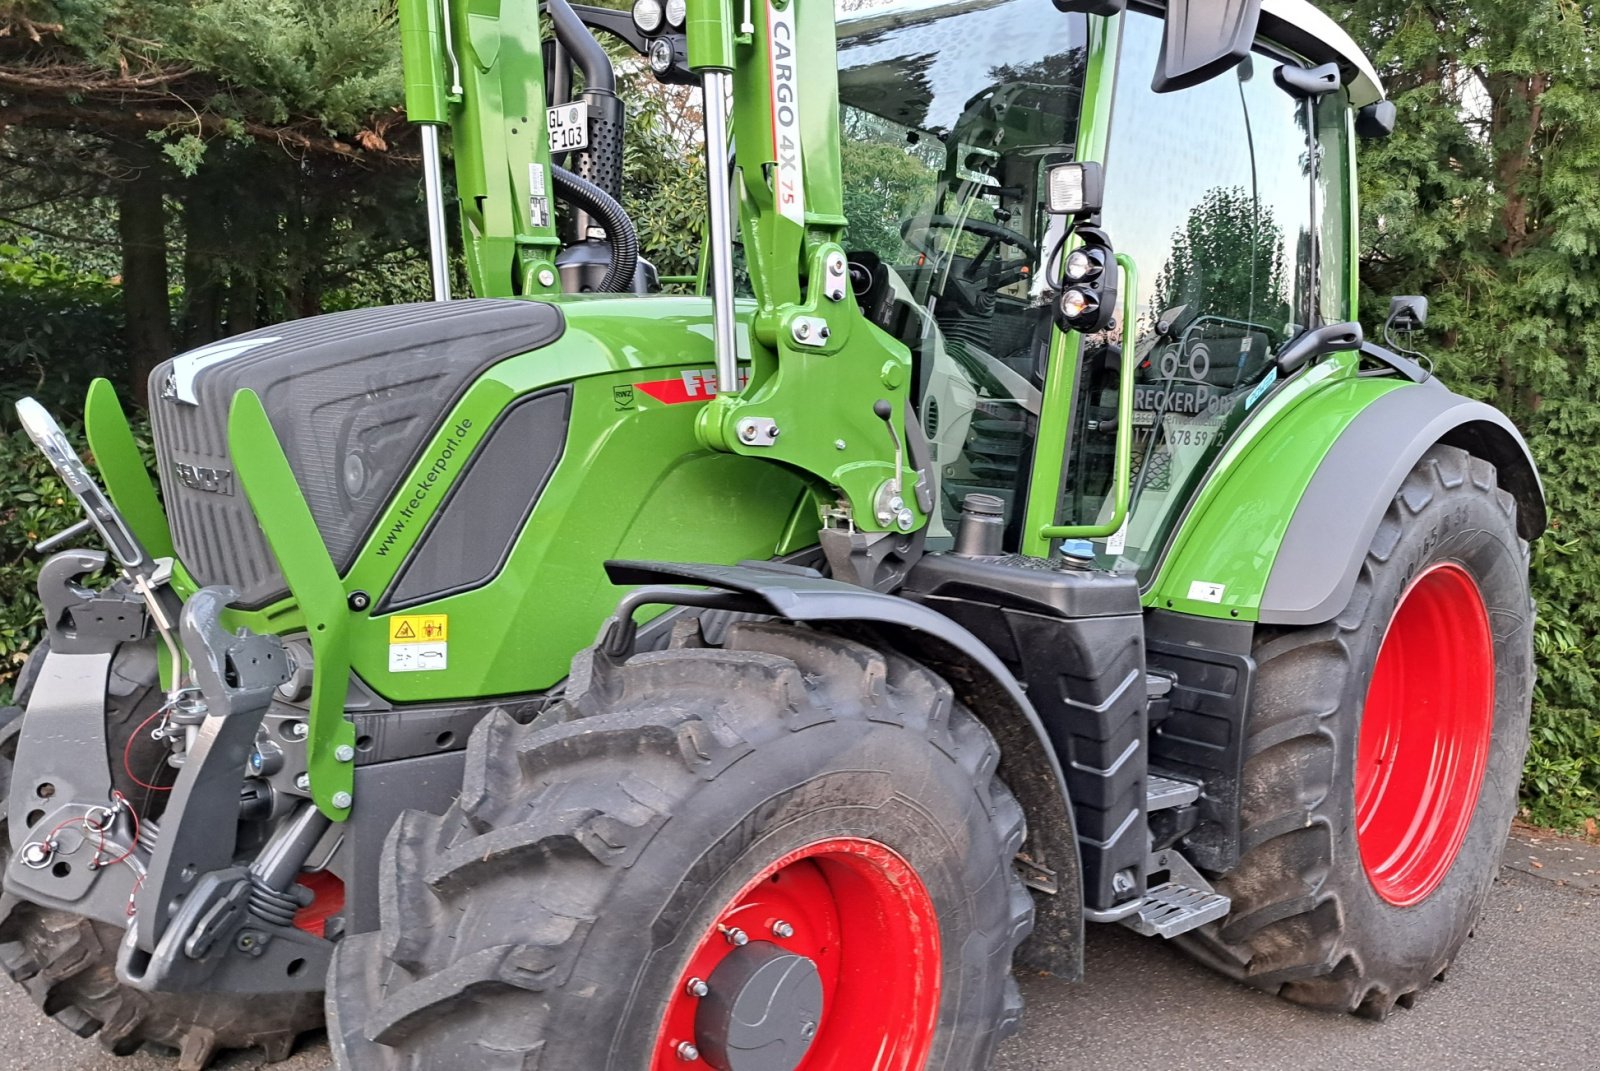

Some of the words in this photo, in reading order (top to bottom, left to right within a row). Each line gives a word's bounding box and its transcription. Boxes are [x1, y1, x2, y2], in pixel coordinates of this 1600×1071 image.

[773, 21, 794, 128] CARGO
[549, 109, 563, 128] GL
[561, 126, 582, 148] 103
[1133, 385, 1237, 415] RECKERPORT
[1169, 429, 1191, 446] 678
[1194, 431, 1208, 447] 59
[376, 418, 473, 557] www.treckerport.de
